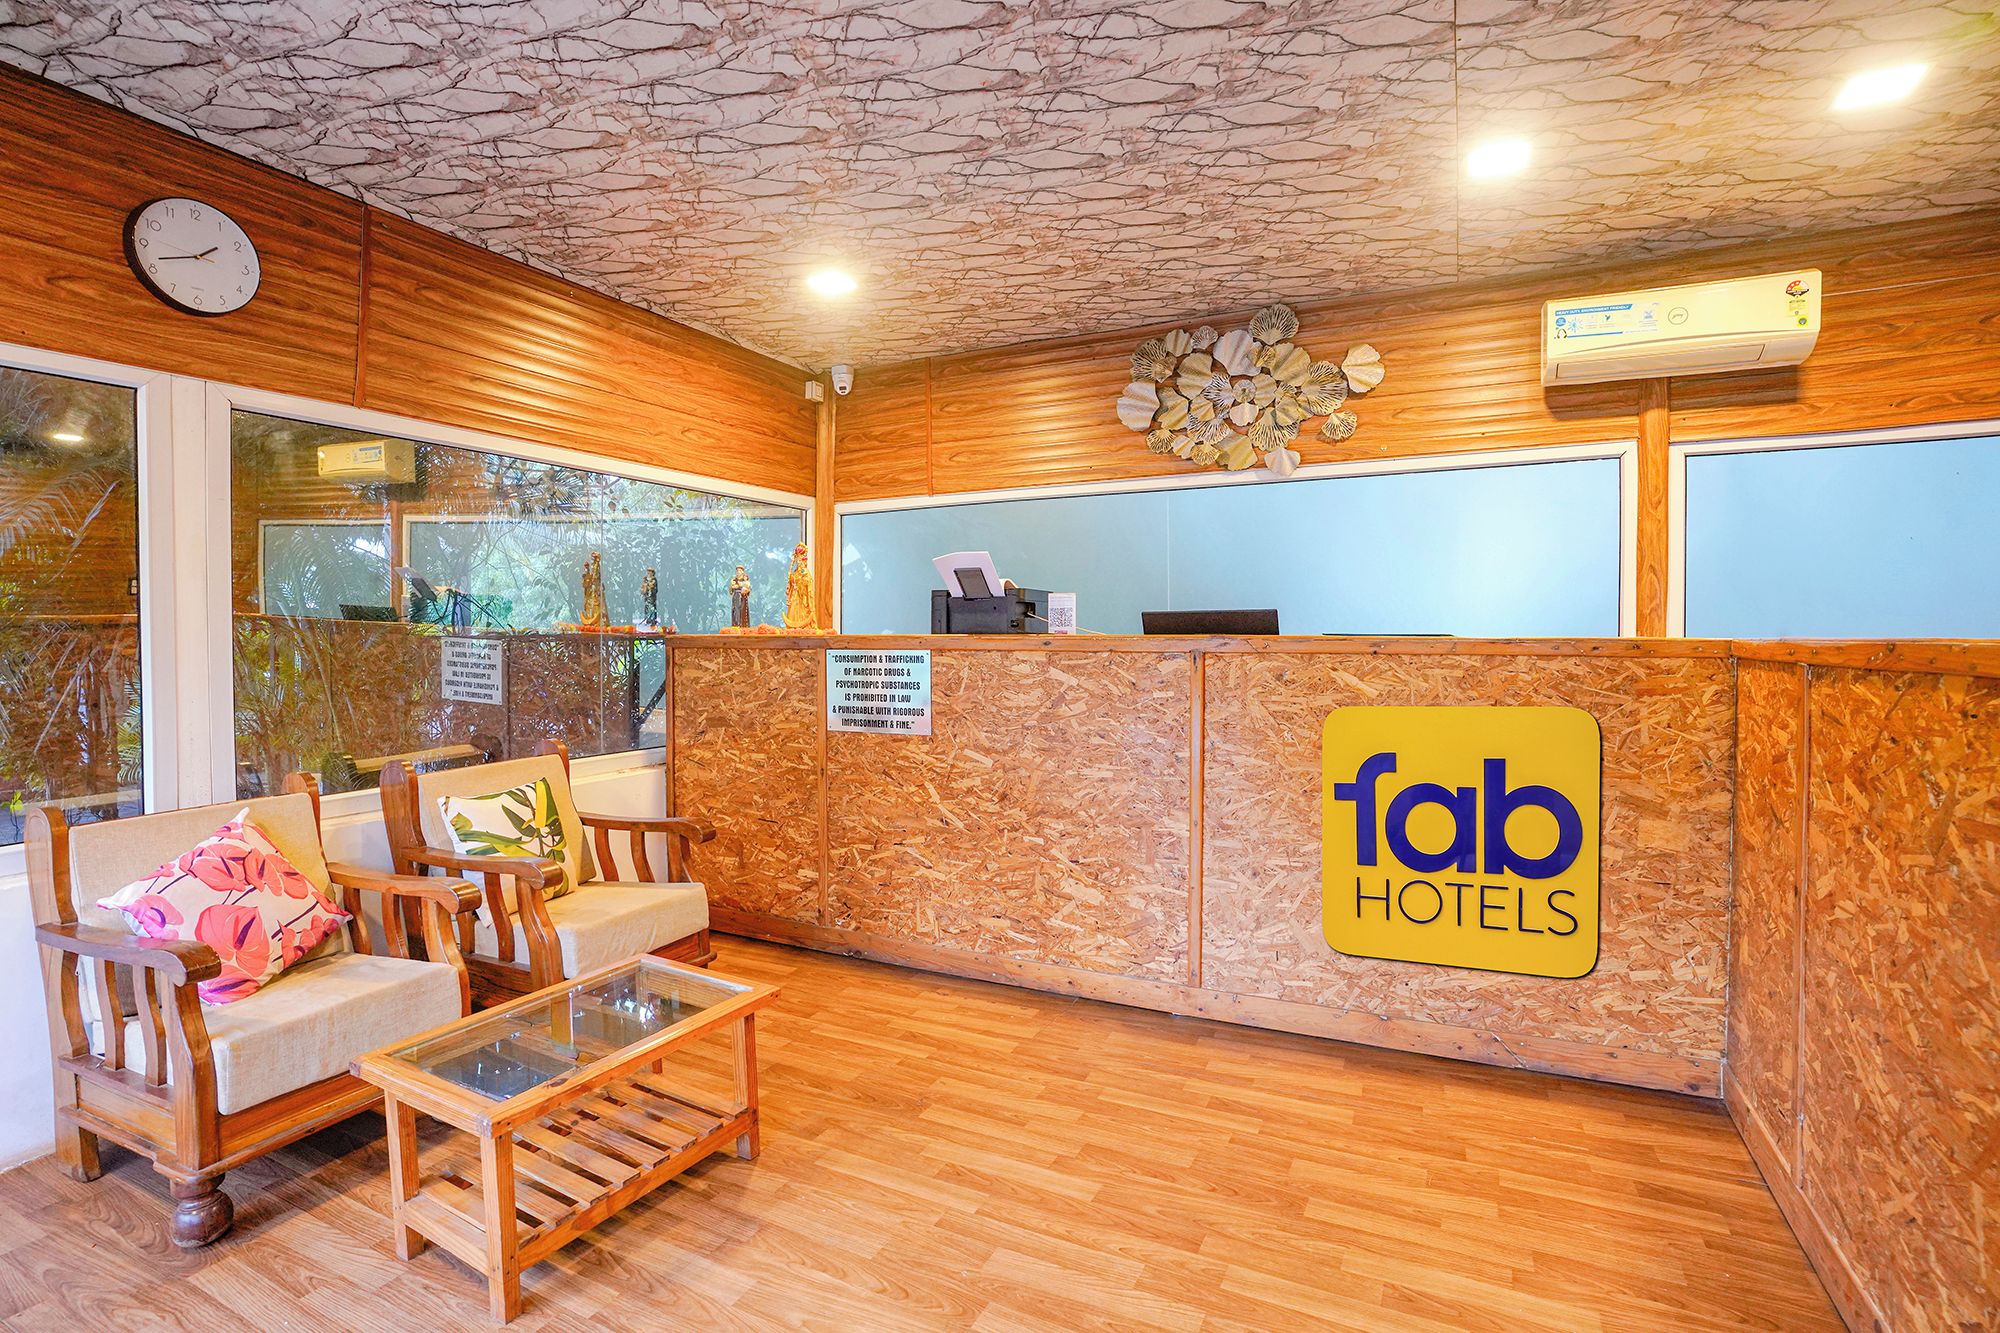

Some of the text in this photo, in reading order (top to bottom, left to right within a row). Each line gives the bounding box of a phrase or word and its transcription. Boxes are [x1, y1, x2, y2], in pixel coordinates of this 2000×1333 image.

[165, 206, 175, 219] 11
[190, 208, 201, 221] 12
[145, 218, 162, 232] 10
[218, 222, 222, 232] 1
[138, 238, 149, 249] 9
[233, 241, 242, 253] 2
[148, 263, 158, 274] 8
[241, 265, 250, 276] 3
[170, 282, 177, 293] 7
[236, 285, 243, 294] 4
[193, 295, 202, 306] 6
[220, 295, 226, 306] 5
[879, 655, 883, 663] &
[885, 655, 924, 664] TRAFFICKING
[844, 668, 911, 676] OF NARCOTIC DRUGS &
[836, 680, 921, 690] PSYCHOTROPIC SUBSTANCES
[845, 693, 851, 701] IS
[852, 693, 887, 702] PROHIBITED
[898, 694, 911, 703] LAW
[838, 706, 874, 715] PUNISHABLE
[876, 707, 891, 715] WITH
[893, 707, 924, 716] RIGOROUS
[842, 718, 888, 728] IMPRISONMENT
[1334, 752, 1583, 879] fab
[1356, 877, 1578, 936] HOTELS
